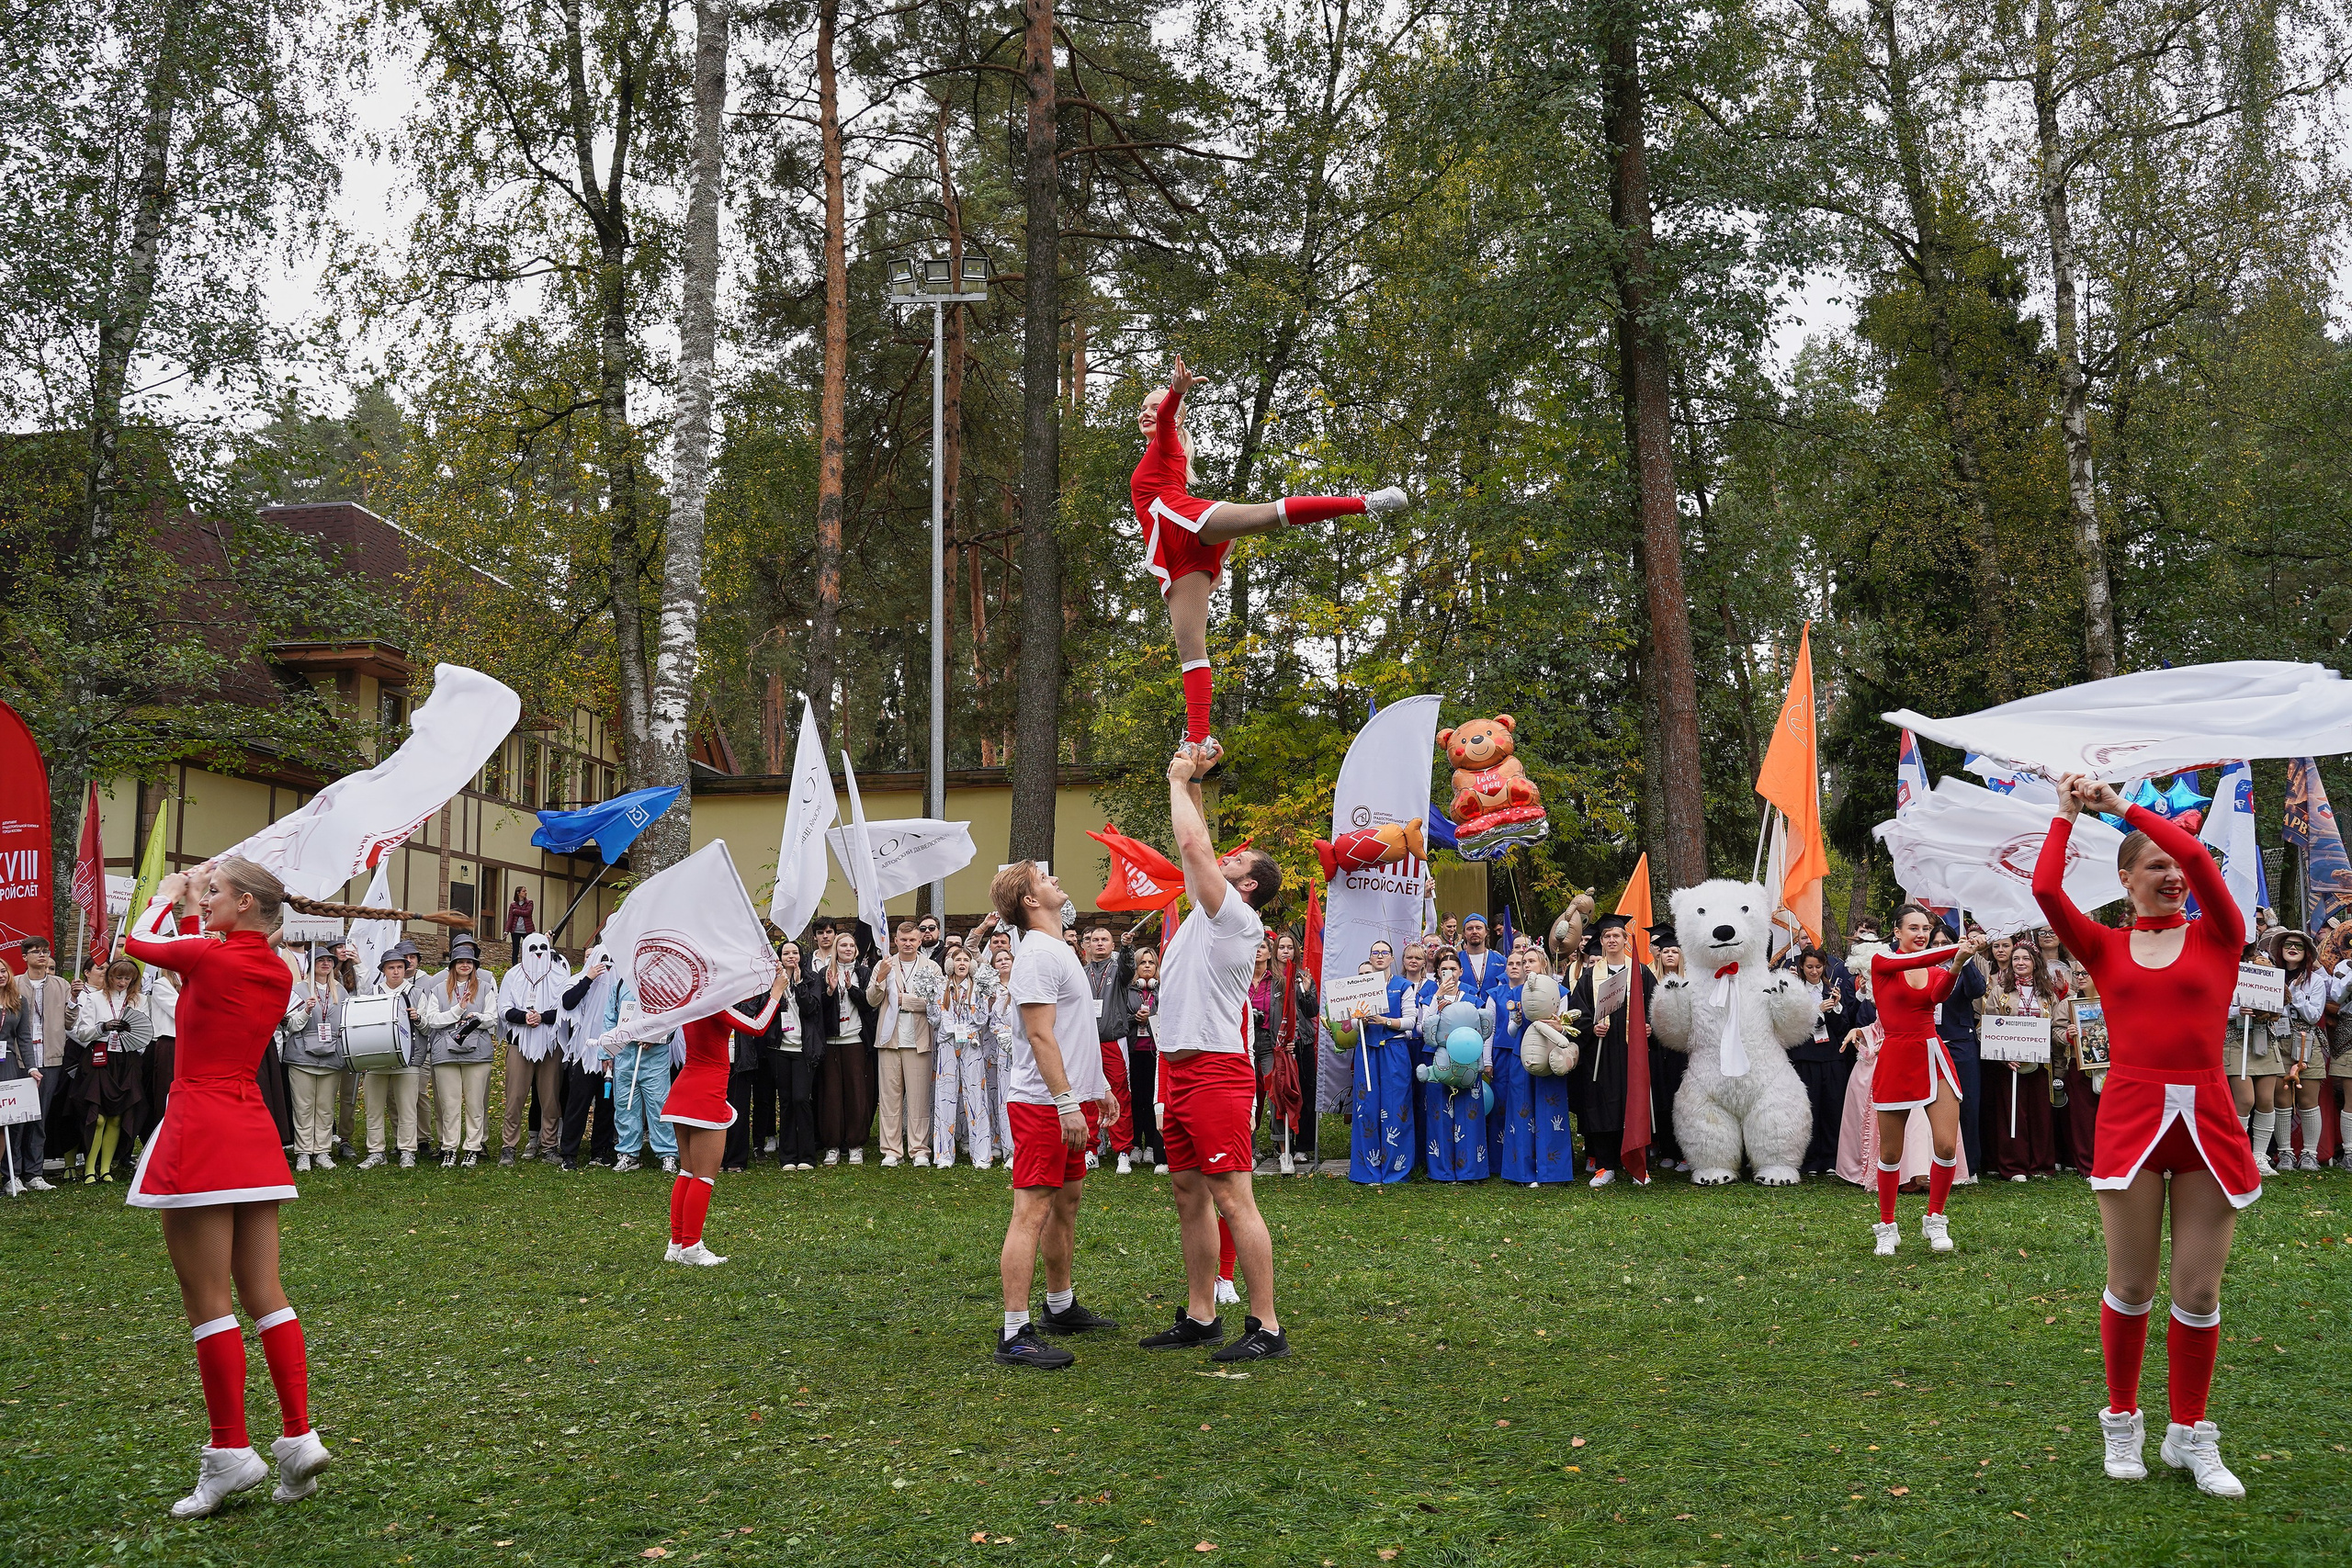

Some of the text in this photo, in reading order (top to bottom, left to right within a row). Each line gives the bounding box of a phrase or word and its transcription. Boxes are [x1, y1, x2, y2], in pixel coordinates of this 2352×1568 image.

[1476, 773, 1499, 785] love
[1482, 781, 1502, 795] you
[1346, 875, 1419, 896] СТРОЙСЛЁТ
[1330, 989, 1385, 1004] МОНАРХ-ПРОЕКТ
[1984, 1034, 2047, 1043] МОСГОРГЕОТРЕСТ
[0, 1097, 17, 1109] ГИ
